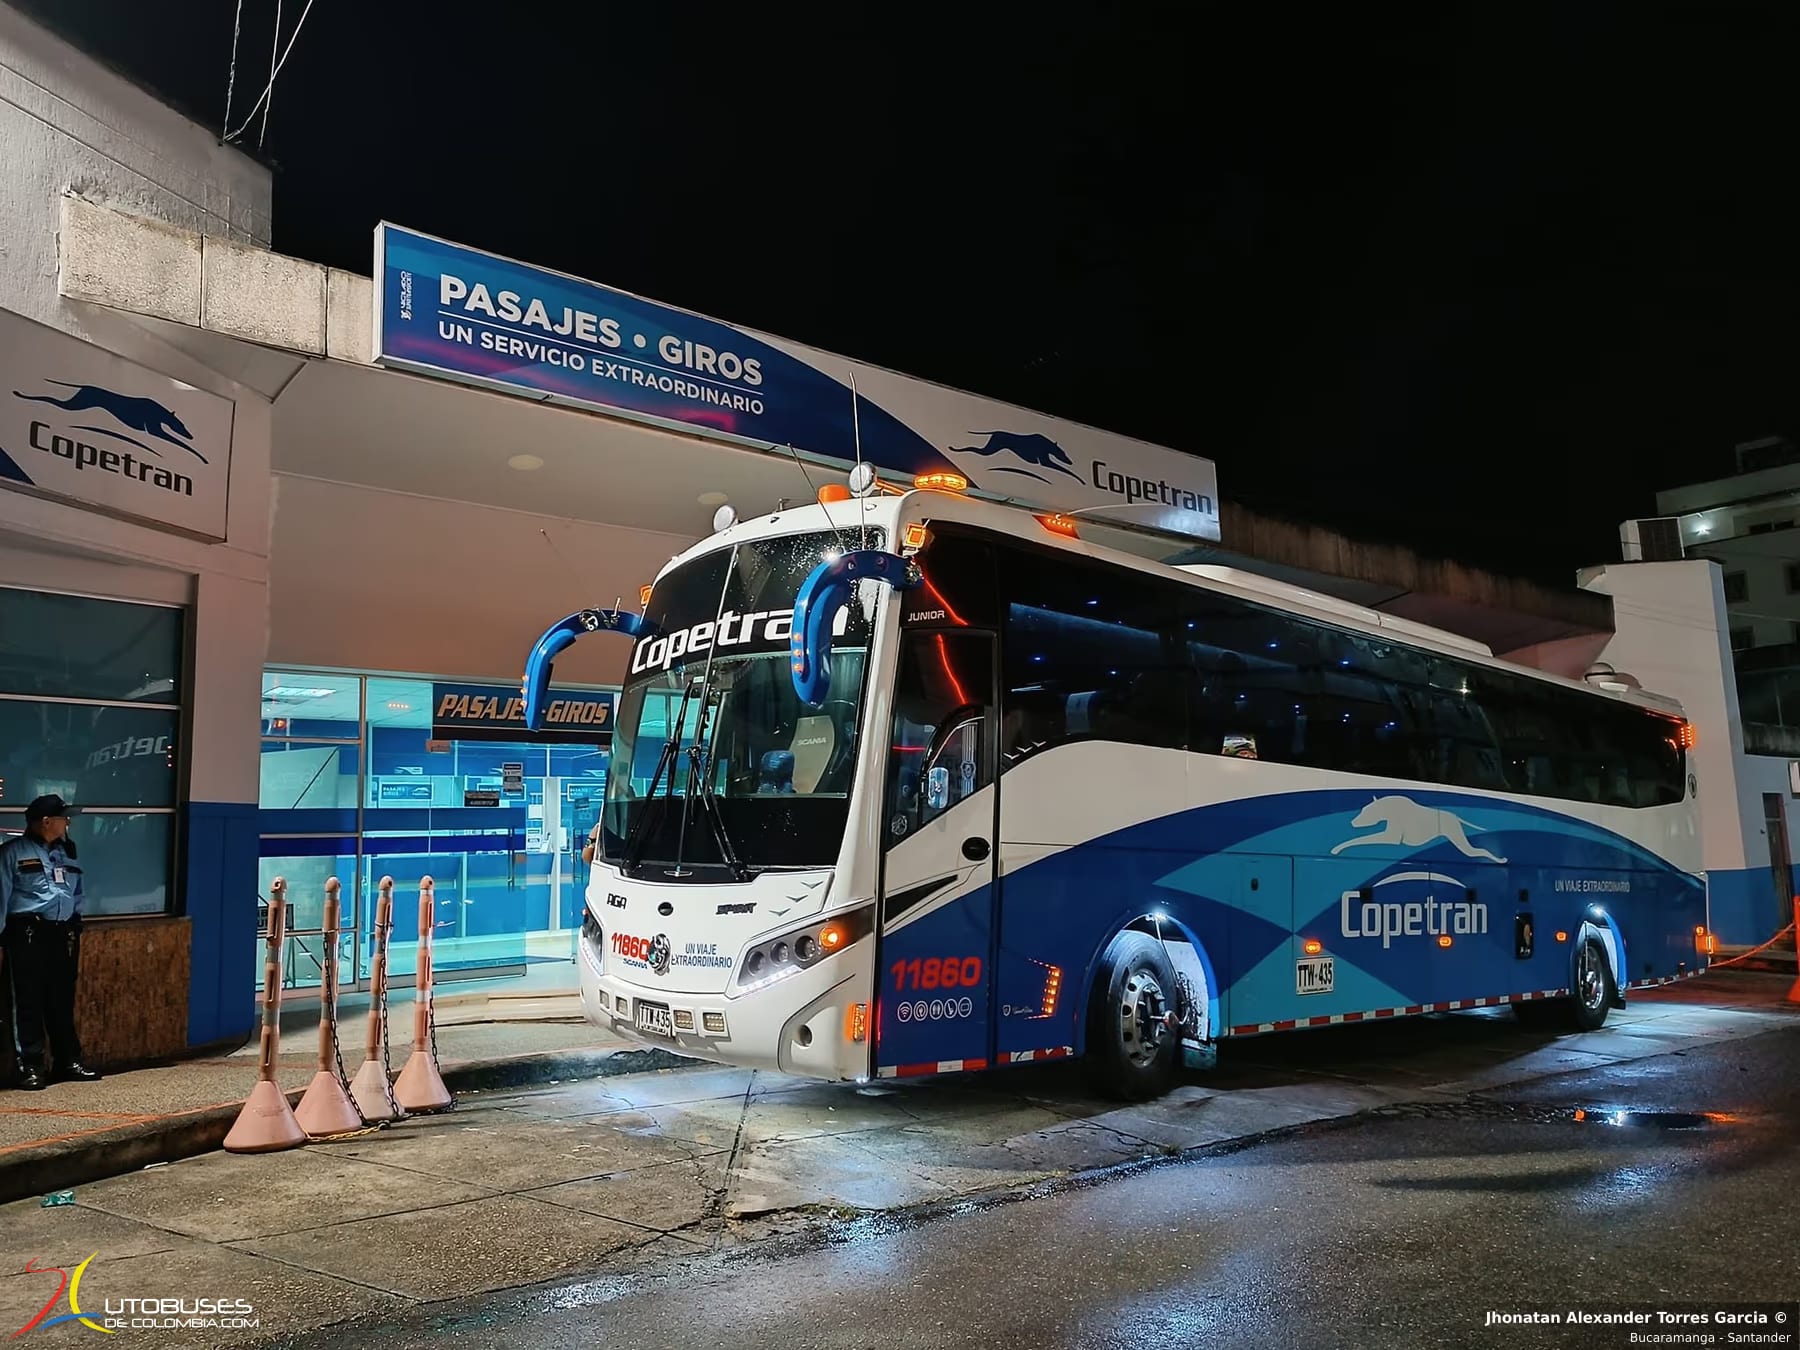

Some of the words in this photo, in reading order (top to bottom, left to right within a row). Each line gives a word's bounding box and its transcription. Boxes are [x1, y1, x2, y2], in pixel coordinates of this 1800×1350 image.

[439, 273, 622, 348] PASAJES
[658, 334, 763, 386] GIROS
[438, 320, 473, 346] UN
[480, 331, 585, 371] SERVICIO
[592, 358, 764, 415] EXTRAORDINARIO
[29, 420, 193, 497] Copetran
[1092, 460, 1213, 515] Copetran
[907, 609, 946, 622] JUNIOR
[437, 694, 527, 721] PASAJE
[545, 700, 610, 725] GIROS
[606, 892, 628, 910] AGA
[1554, 879, 1565, 892] UN
[1565, 879, 1581, 893] VIAJE
[1341, 890, 1488, 949] Copetran
[611, 932, 650, 962] 11860
[671, 953, 733, 969] EXTRAORDINARIO
[685, 943, 697, 955] UN
[697, 943, 717, 956] VIAJE
[890, 955, 983, 991] 11860
